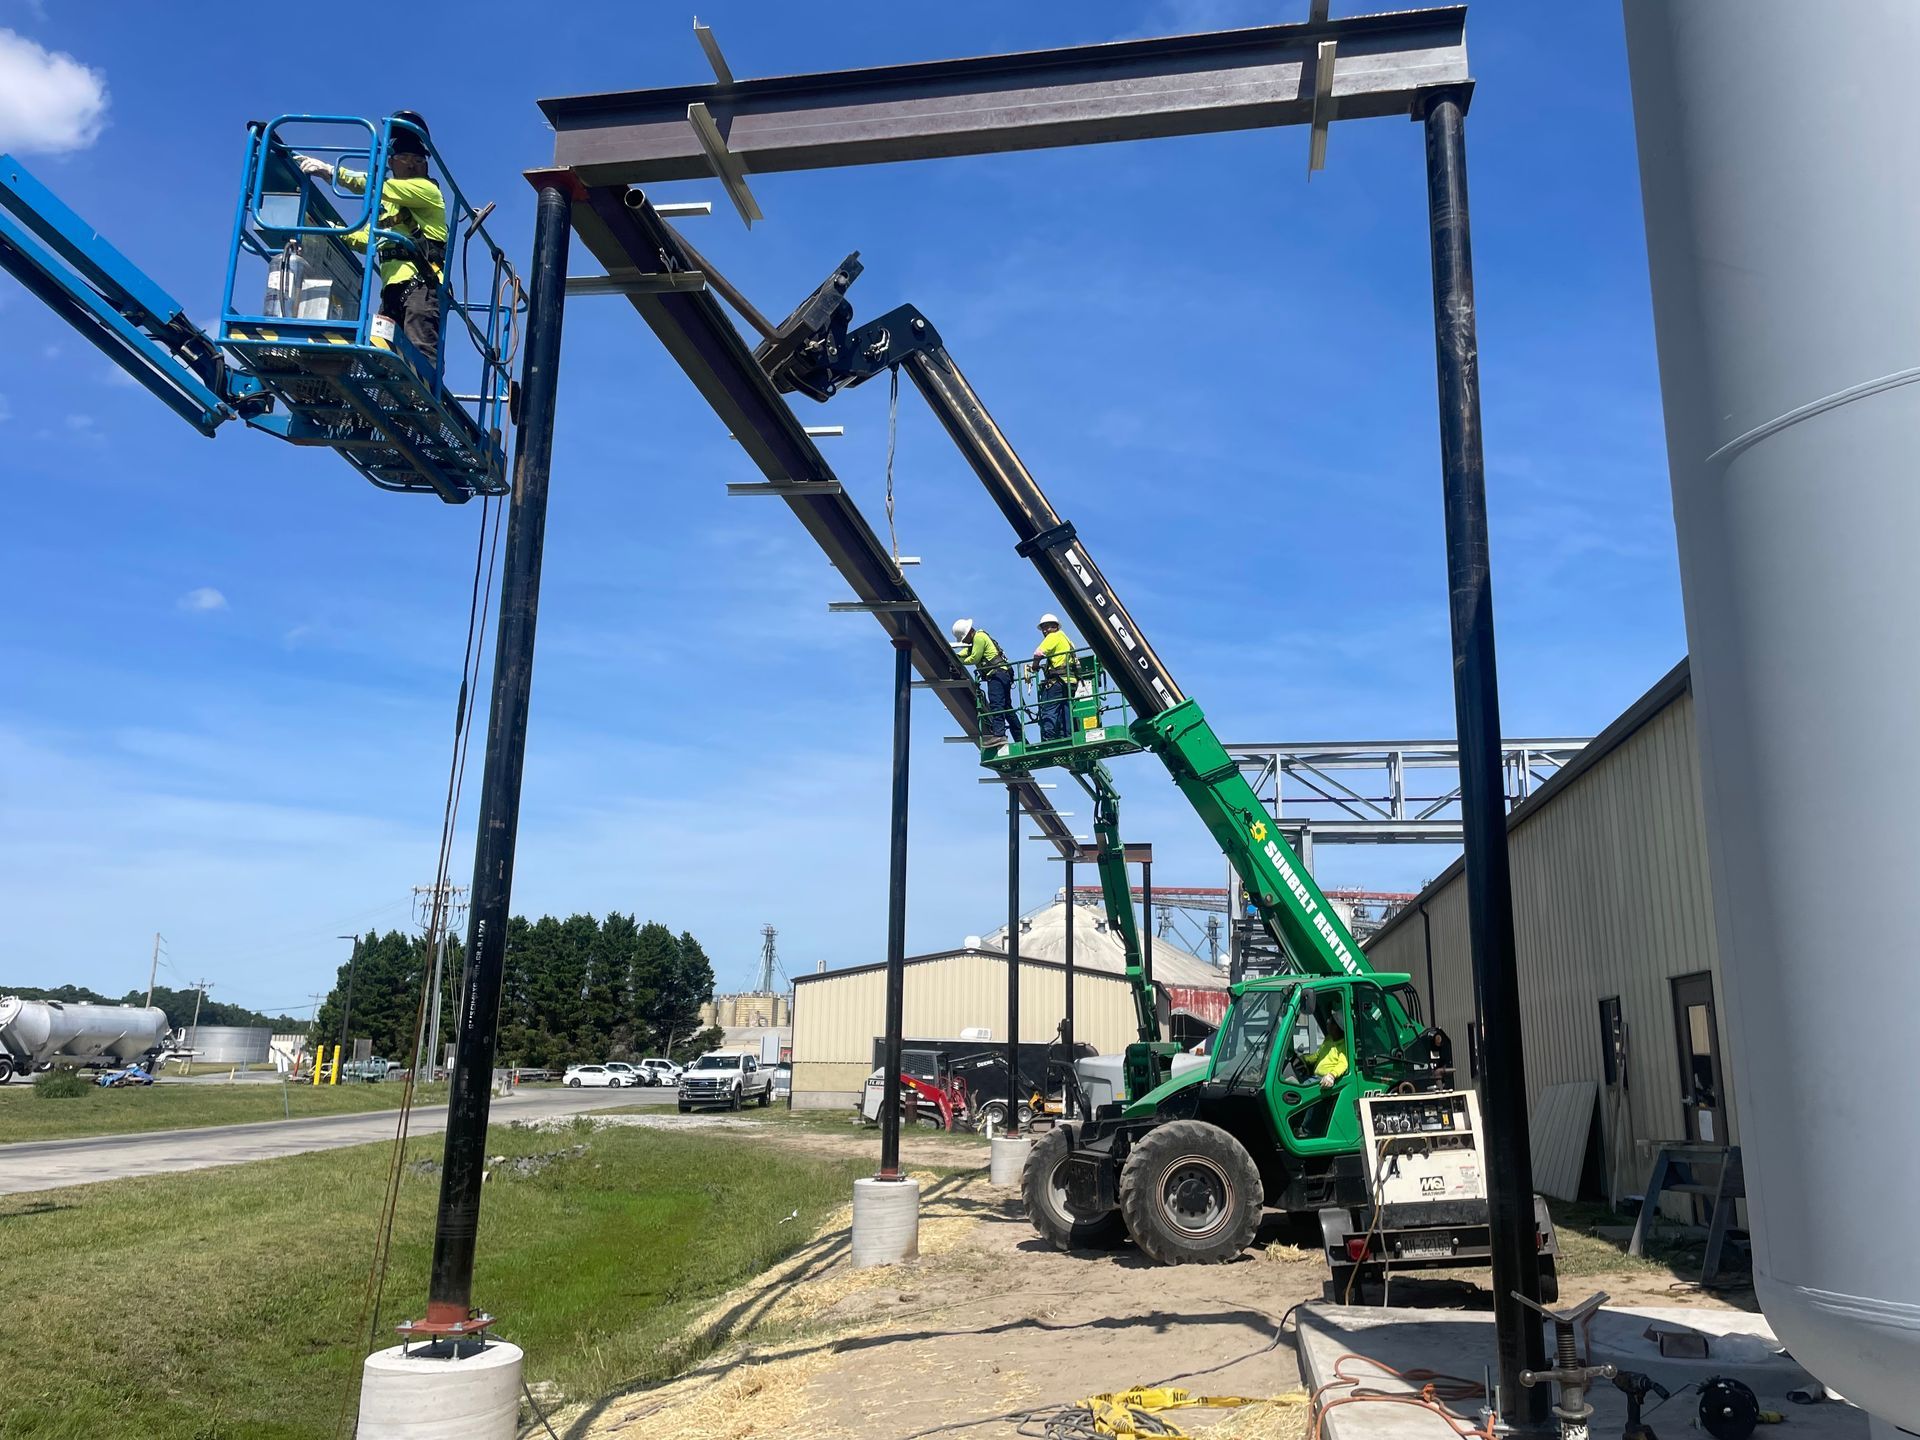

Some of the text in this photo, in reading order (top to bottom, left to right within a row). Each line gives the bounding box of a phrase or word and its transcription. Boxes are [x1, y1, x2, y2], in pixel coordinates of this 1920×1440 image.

[1094, 593, 1106, 607] B
[1137, 656, 1149, 670] D
[1263, 840, 1318, 915] SUNBELT
[1420, 1176, 1445, 1191] MQ
